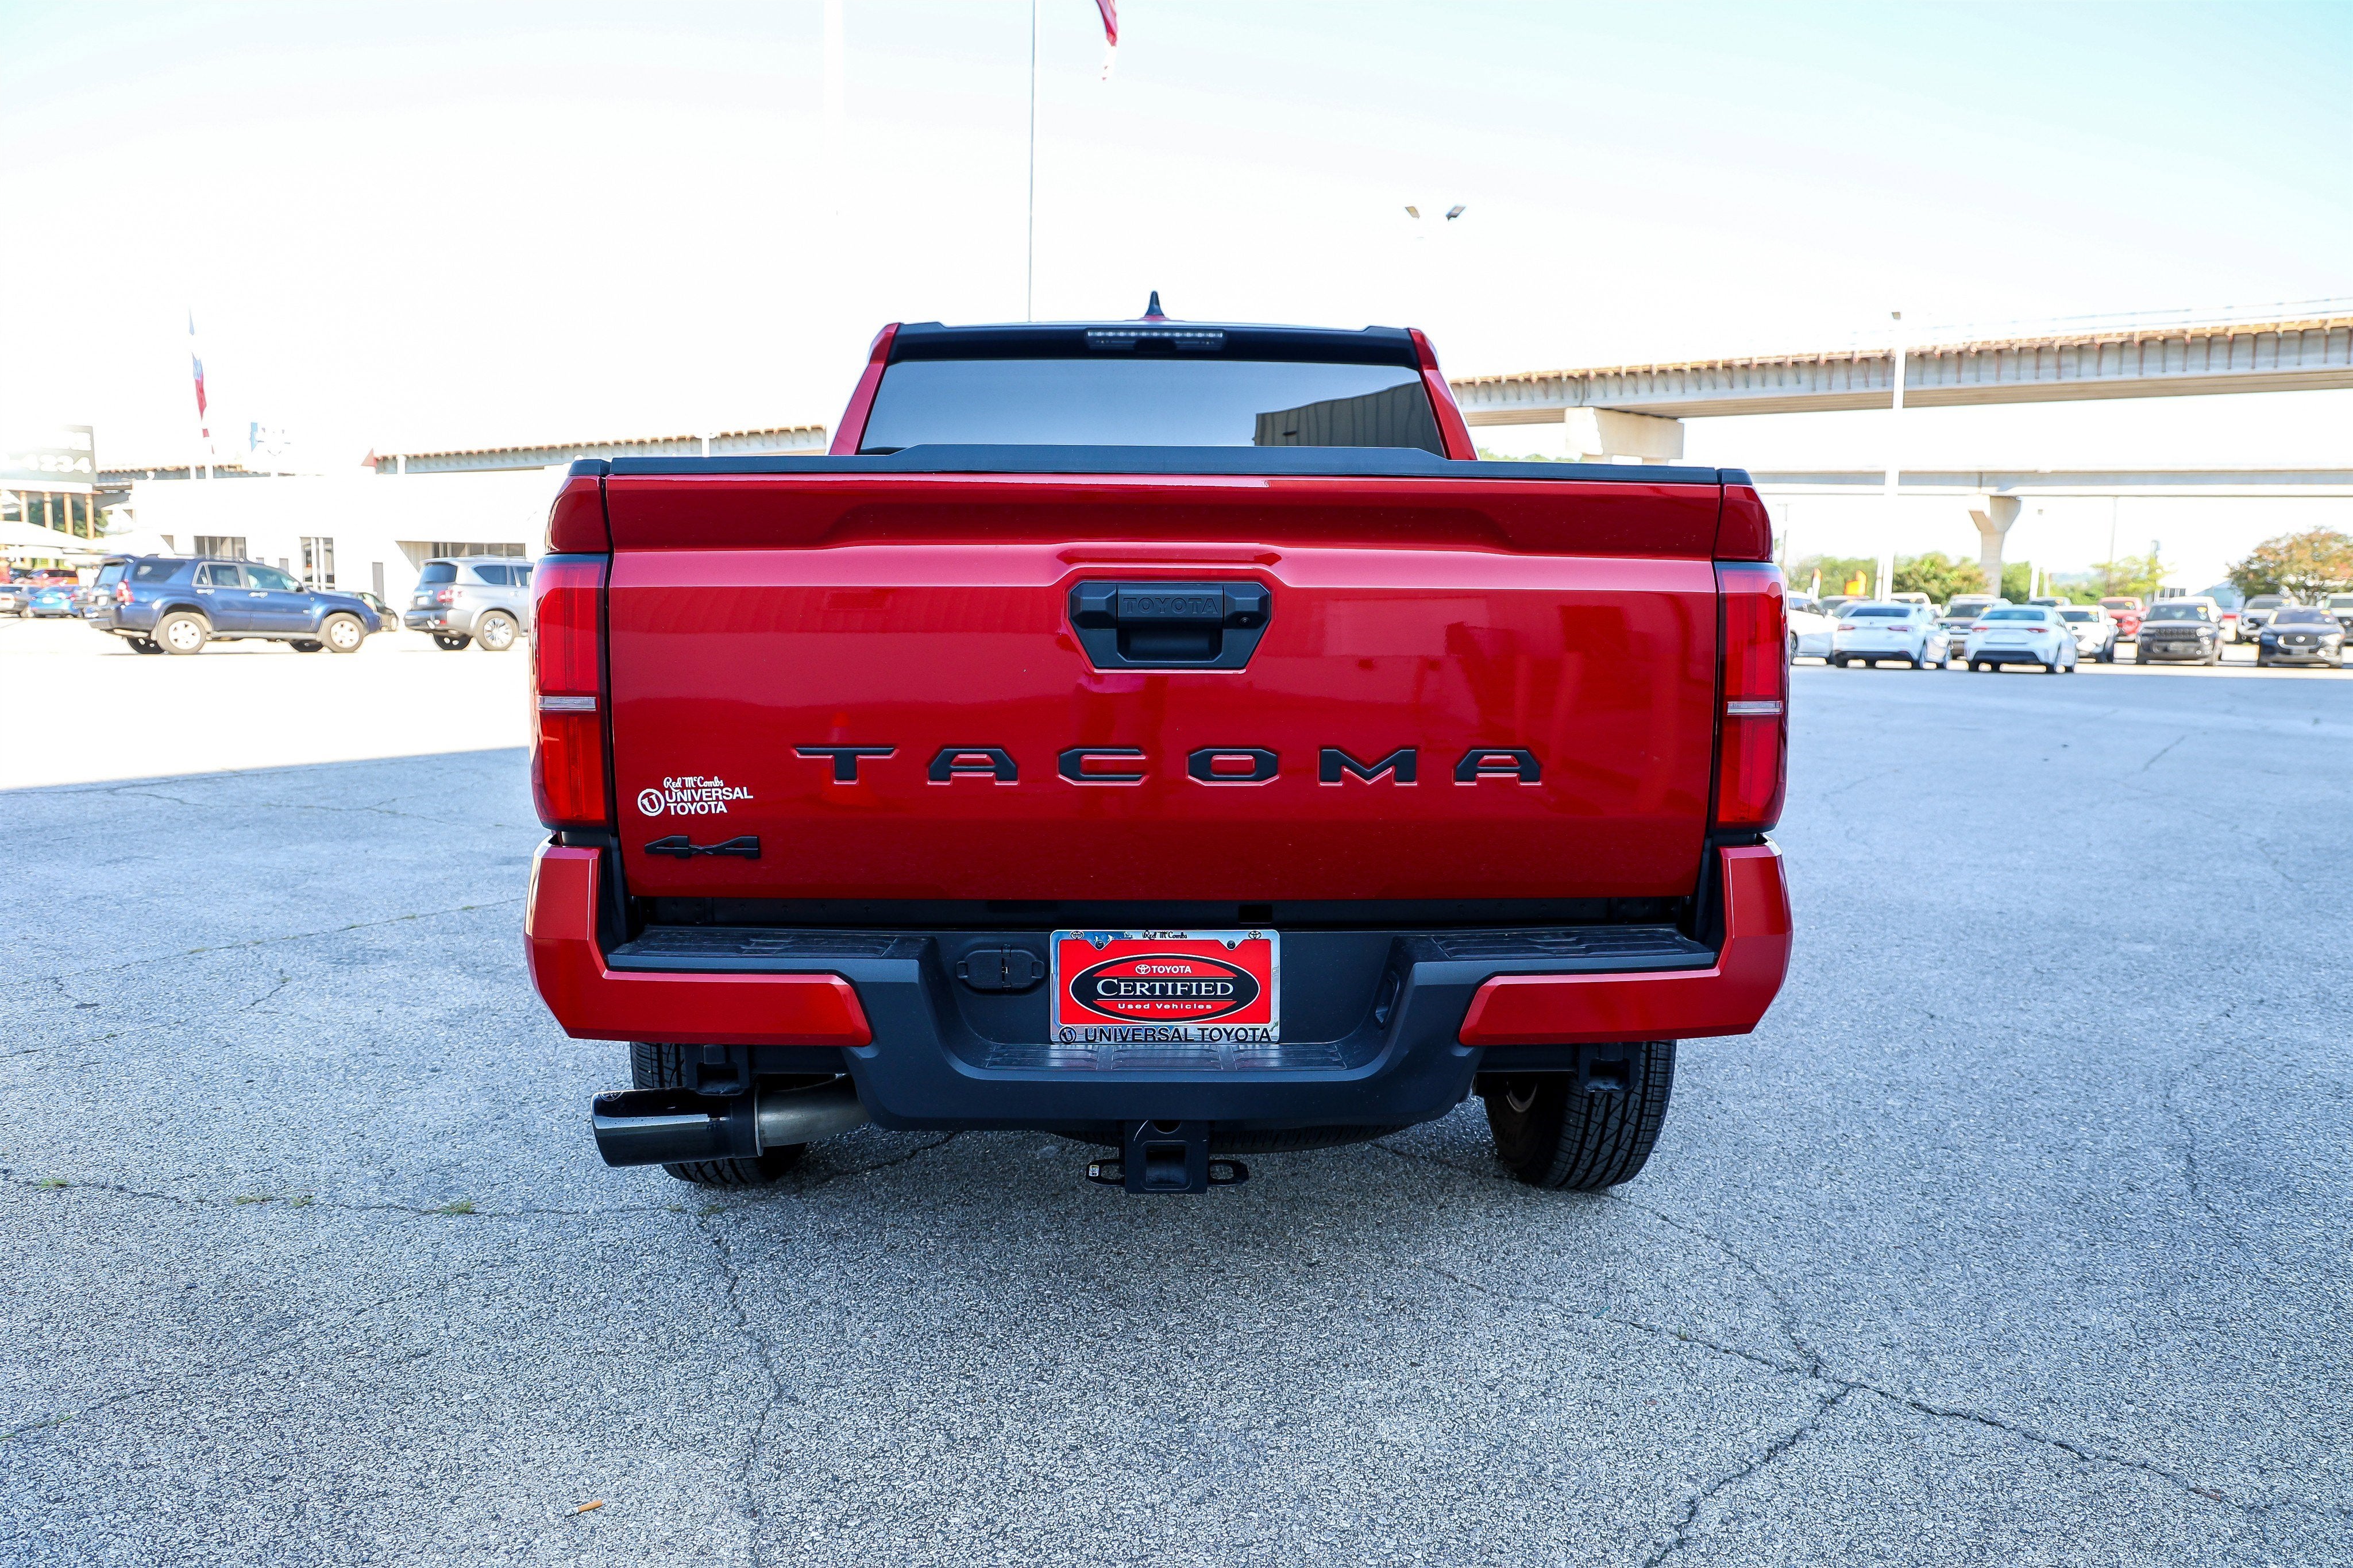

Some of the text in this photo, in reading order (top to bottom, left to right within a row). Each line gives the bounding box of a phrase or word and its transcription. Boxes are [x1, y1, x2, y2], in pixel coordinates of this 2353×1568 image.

[1123, 597, 1218, 614] TOYOTA
[793, 747, 1542, 786] TACOMA
[664, 776, 724, 791] Red McCombs
[665, 787, 753, 802] UNIVERSAL
[667, 801, 727, 816] TOYOTA
[1143, 930, 1187, 940] Red McCombs
[1151, 965, 1192, 974] TOYOTA
[1085, 1027, 1194, 1042] UNIVERSAL
[1199, 1027, 1272, 1042] TOYOTA
